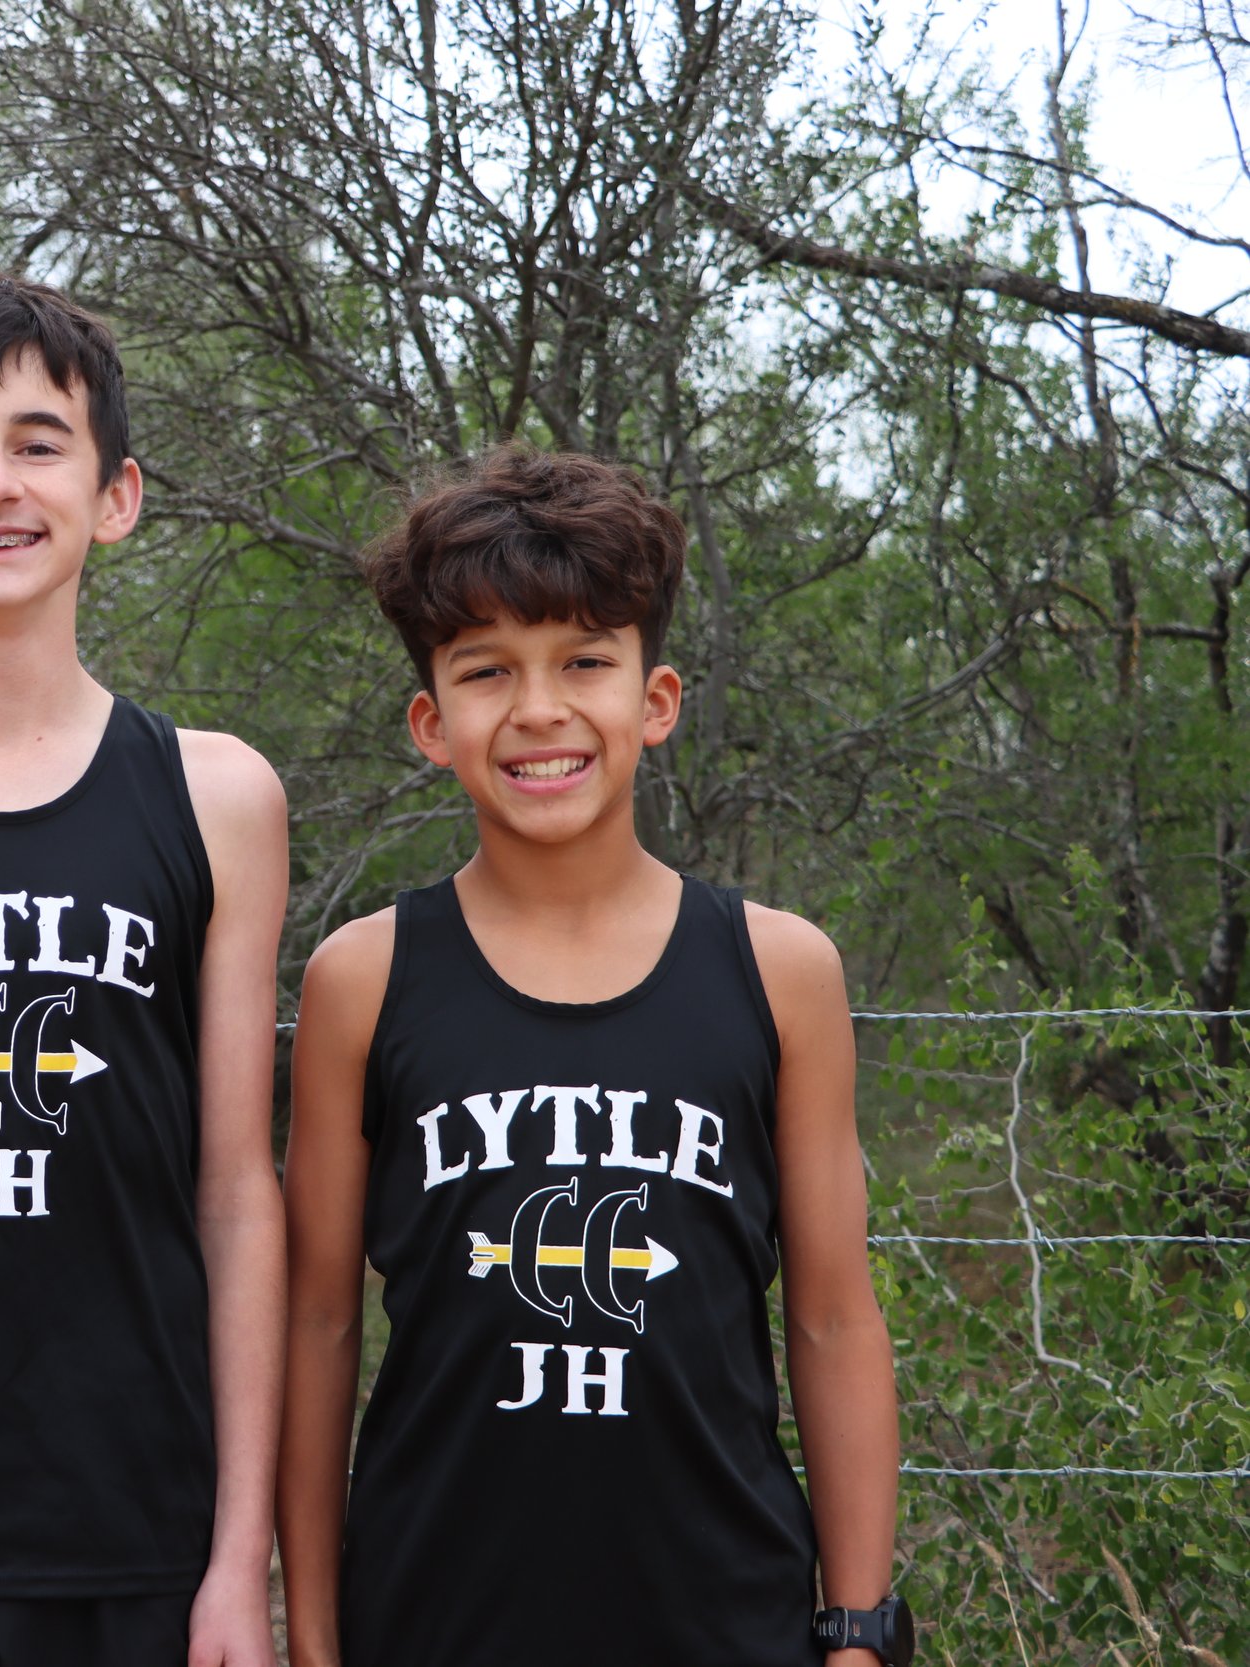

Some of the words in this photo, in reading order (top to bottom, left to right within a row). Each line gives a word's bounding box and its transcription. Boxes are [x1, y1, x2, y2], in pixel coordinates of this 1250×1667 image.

[415, 1083, 734, 1199] LYTLE
[509, 1175, 648, 1334] CC
[496, 1342, 630, 1416] JH
